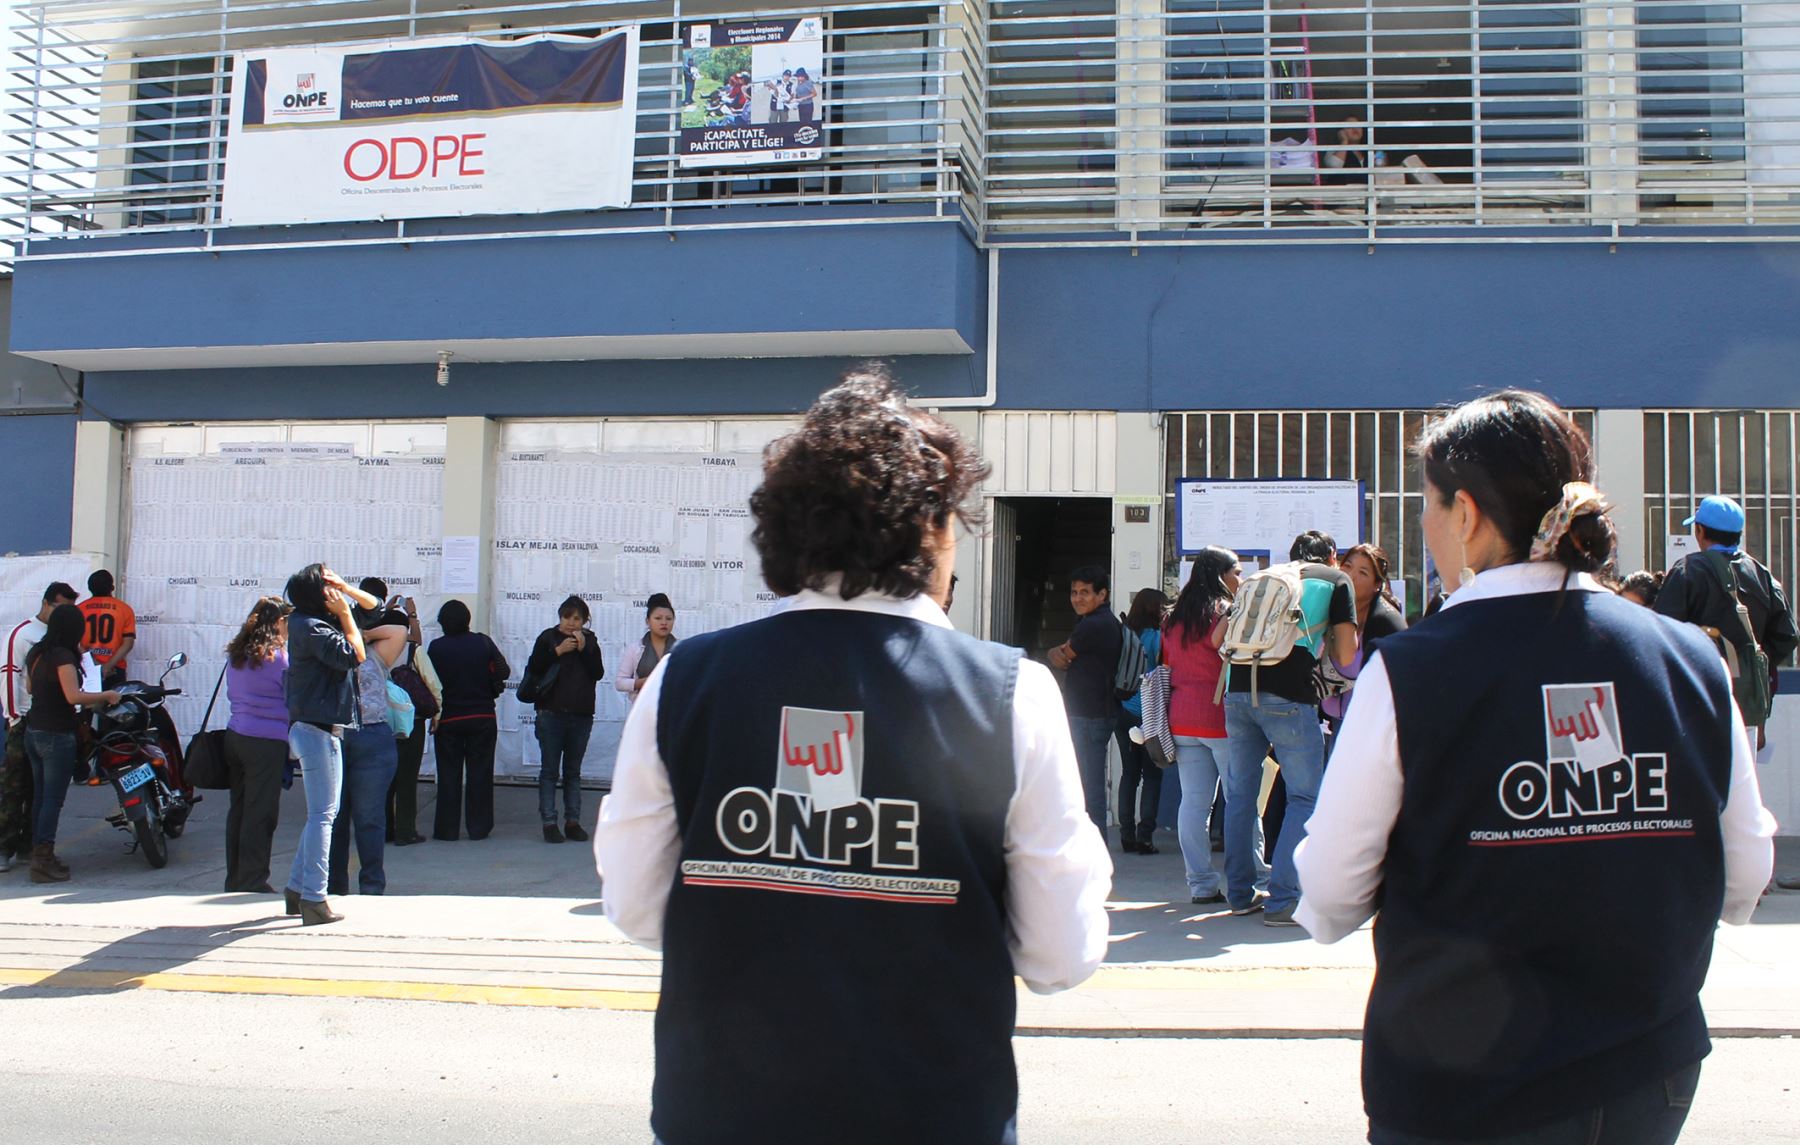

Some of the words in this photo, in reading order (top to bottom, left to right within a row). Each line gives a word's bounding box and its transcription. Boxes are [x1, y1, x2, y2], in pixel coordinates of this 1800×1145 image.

[283, 92, 327, 108] ONPE
[350, 98, 386, 109] Hacemos
[388, 98, 402, 109] que
[404, 96, 413, 105] tu
[414, 95, 430, 105] voto
[432, 94, 459, 103] cuente
[690, 140, 740, 151] PARTICIPA
[742, 140, 749, 149] Y
[751, 137, 784, 148] ELIGE!
[343, 133, 486, 181] ODPE
[359, 457, 390, 466] CAYMA
[702, 457, 736, 466] TIABAYA
[496, 540, 526, 549] ISLAY
[529, 542, 559, 550] MEJIA
[623, 545, 661, 553] COCACHACRA
[712, 561, 744, 569] VITOR
[168, 577, 198, 585] CHIGUATA
[391, 577, 421, 585] MOLLEBAY
[506, 592, 540, 600] MOLLENDO
[86, 613, 115, 644] 10
[1498, 753, 1668, 820] ONPE
[716, 786, 919, 870] ONPE
[1469, 829, 1511, 841] OFICINA
[1513, 826, 1568, 840] NACIONAL
[1569, 824, 1584, 835] DE
[1586, 821, 1632, 834] PROCESOS
[1634, 819, 1693, 831] ELECTORALES
[683, 861, 729, 874] OFICINA
[732, 864, 789, 879] NACIONAL
[791, 870, 808, 881] DE
[811, 871, 872, 887] PROCESOS
[875, 877, 958, 893] ELECTORALES
